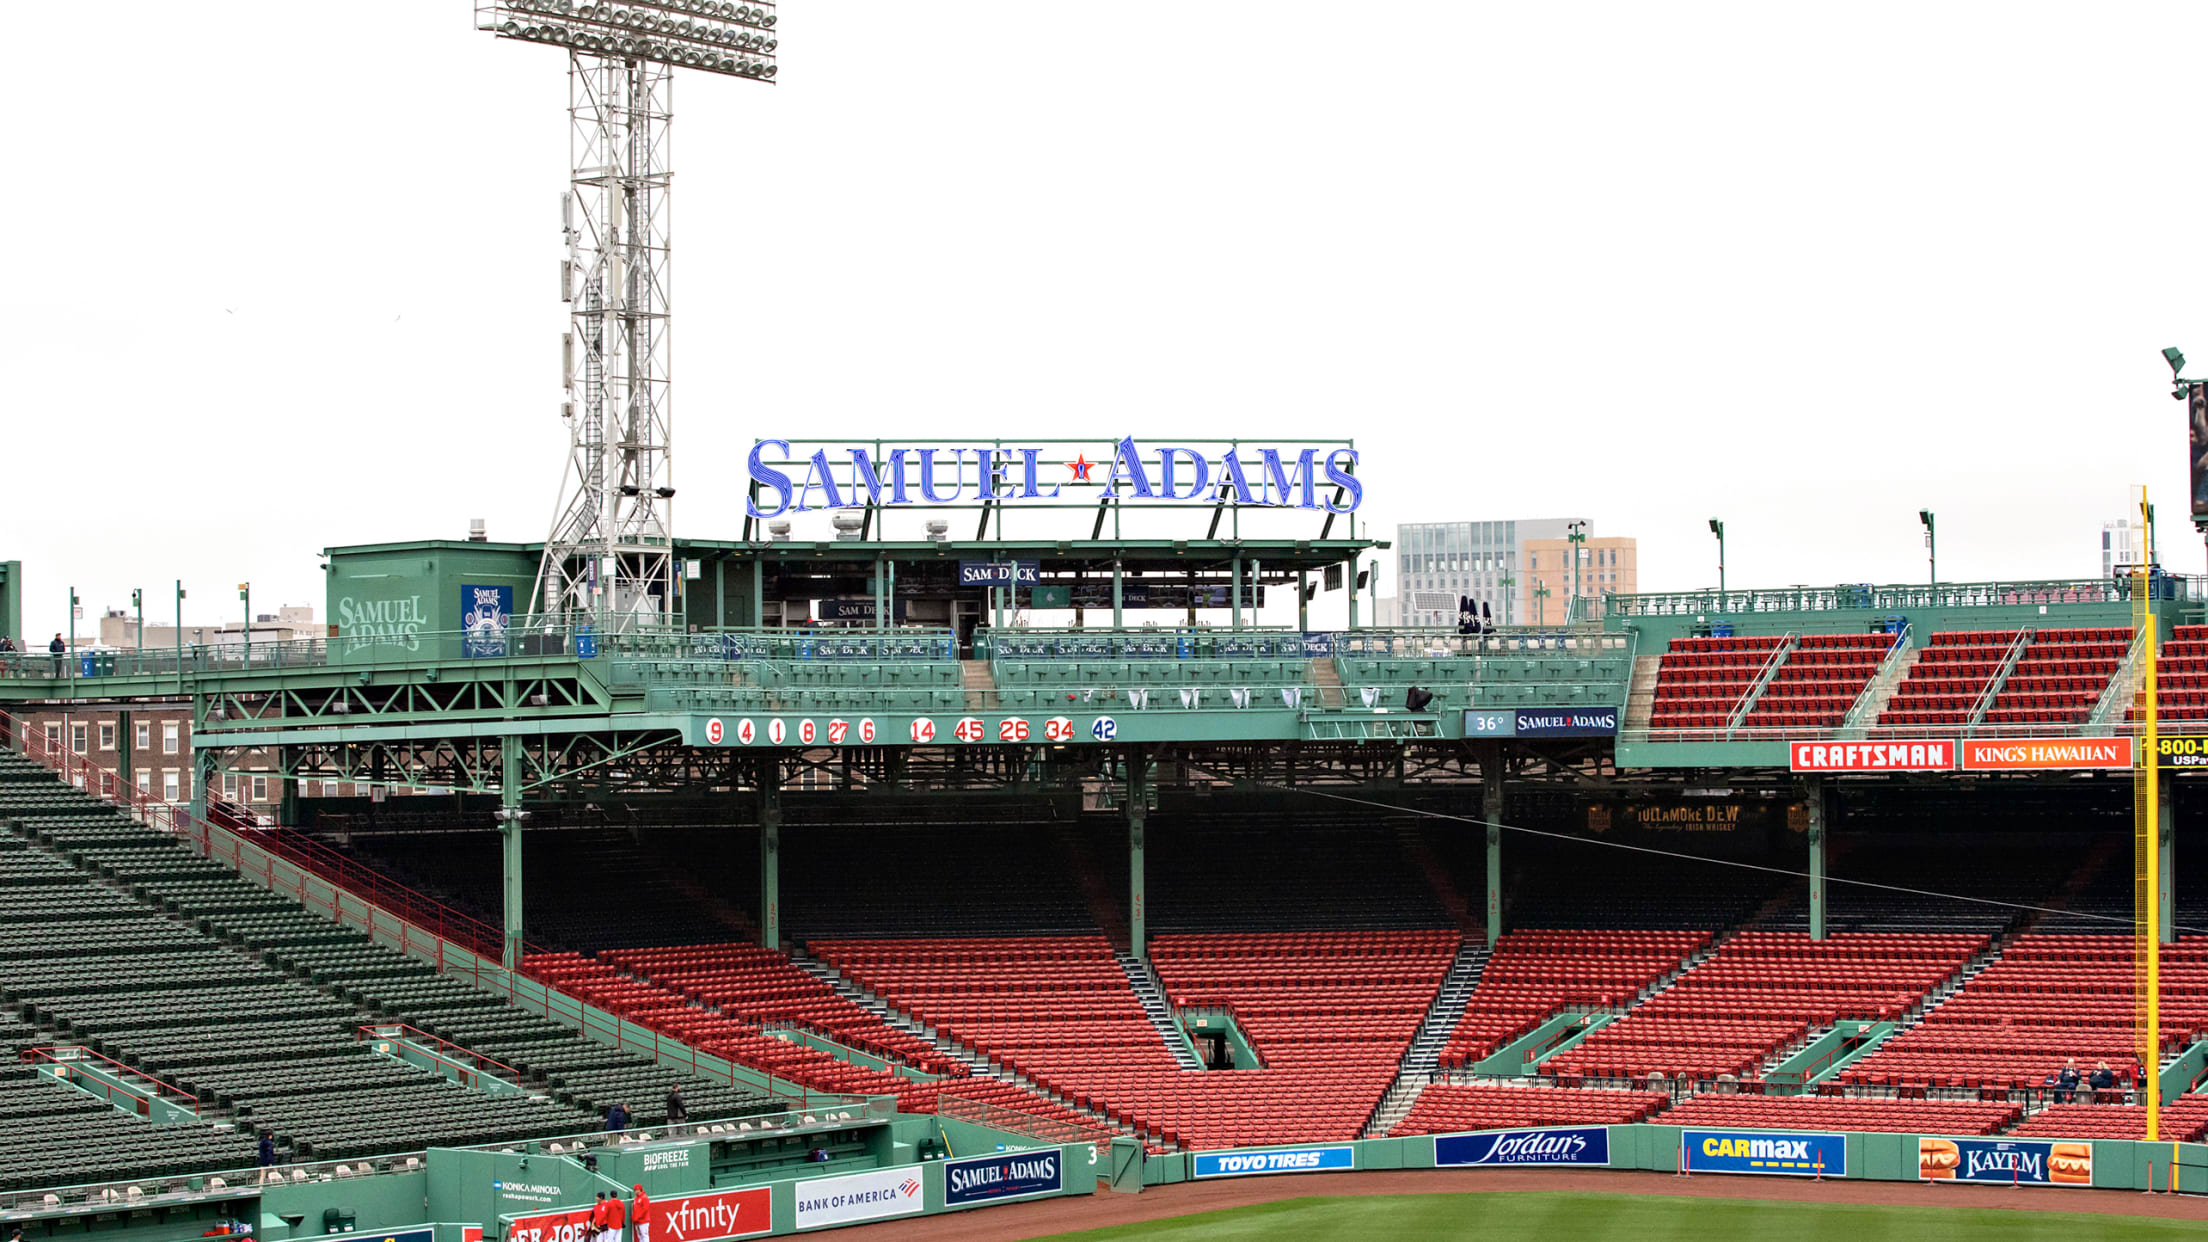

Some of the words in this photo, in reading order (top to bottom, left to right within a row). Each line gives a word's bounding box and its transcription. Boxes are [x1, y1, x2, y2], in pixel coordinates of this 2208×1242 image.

[746, 439, 1060, 519] SAMUEL
[1097, 435, 1363, 514] ADAMS
[963, 567, 992, 582] SAM
[998, 567, 1036, 582] DCK
[473, 587, 501, 599] SAMUEL
[476, 597, 498, 606] ADAMS
[339, 595, 427, 629] SAMUEL
[838, 605, 859, 616] SAM
[344, 623, 420, 656] ADAMS
[711, 722, 722, 742] 9
[742, 722, 752, 742] 4
[775, 722, 781, 742] 1
[803, 722, 814, 742] 8
[828, 722, 849, 742] 27
[863, 721, 874, 741] 6
[911, 721, 934, 740] 14
[954, 721, 984, 740] 45
[1000, 720, 1029, 739] 26
[1045, 720, 1074, 739] 34
[1092, 720, 1115, 738] 42
[1476, 717, 1504, 731] 36°
[1517, 716, 1566, 731] SAMUEL
[1571, 714, 1615, 729] ADAMS
[1798, 743, 1944, 767] CRAFTSMAN
[1975, 746, 2027, 763] KING'S
[2032, 745, 2116, 761] HAWAIIAN
[644, 1150, 689, 1166] BIOFREEZE
[1462, 1133, 1587, 1163] Jordan's
[1499, 1153, 1577, 1162] FURNITURE
[1702, 1138, 1809, 1159] CARmax
[1218, 1156, 1267, 1171] TOYO
[1268, 1152, 1320, 1168] TIRES
[1966, 1150, 2042, 1180] KAYEM
[951, 1166, 1003, 1192] SAMUEL
[1008, 1157, 1055, 1180] ADAMS
[503, 1182, 530, 1192] KONICA
[530, 1184, 562, 1195] MINOLTA
[800, 1198, 828, 1212] BANK
[832, 1196, 845, 1208] OF
[848, 1189, 897, 1205] AMERICA
[665, 1198, 740, 1240] xfinity
